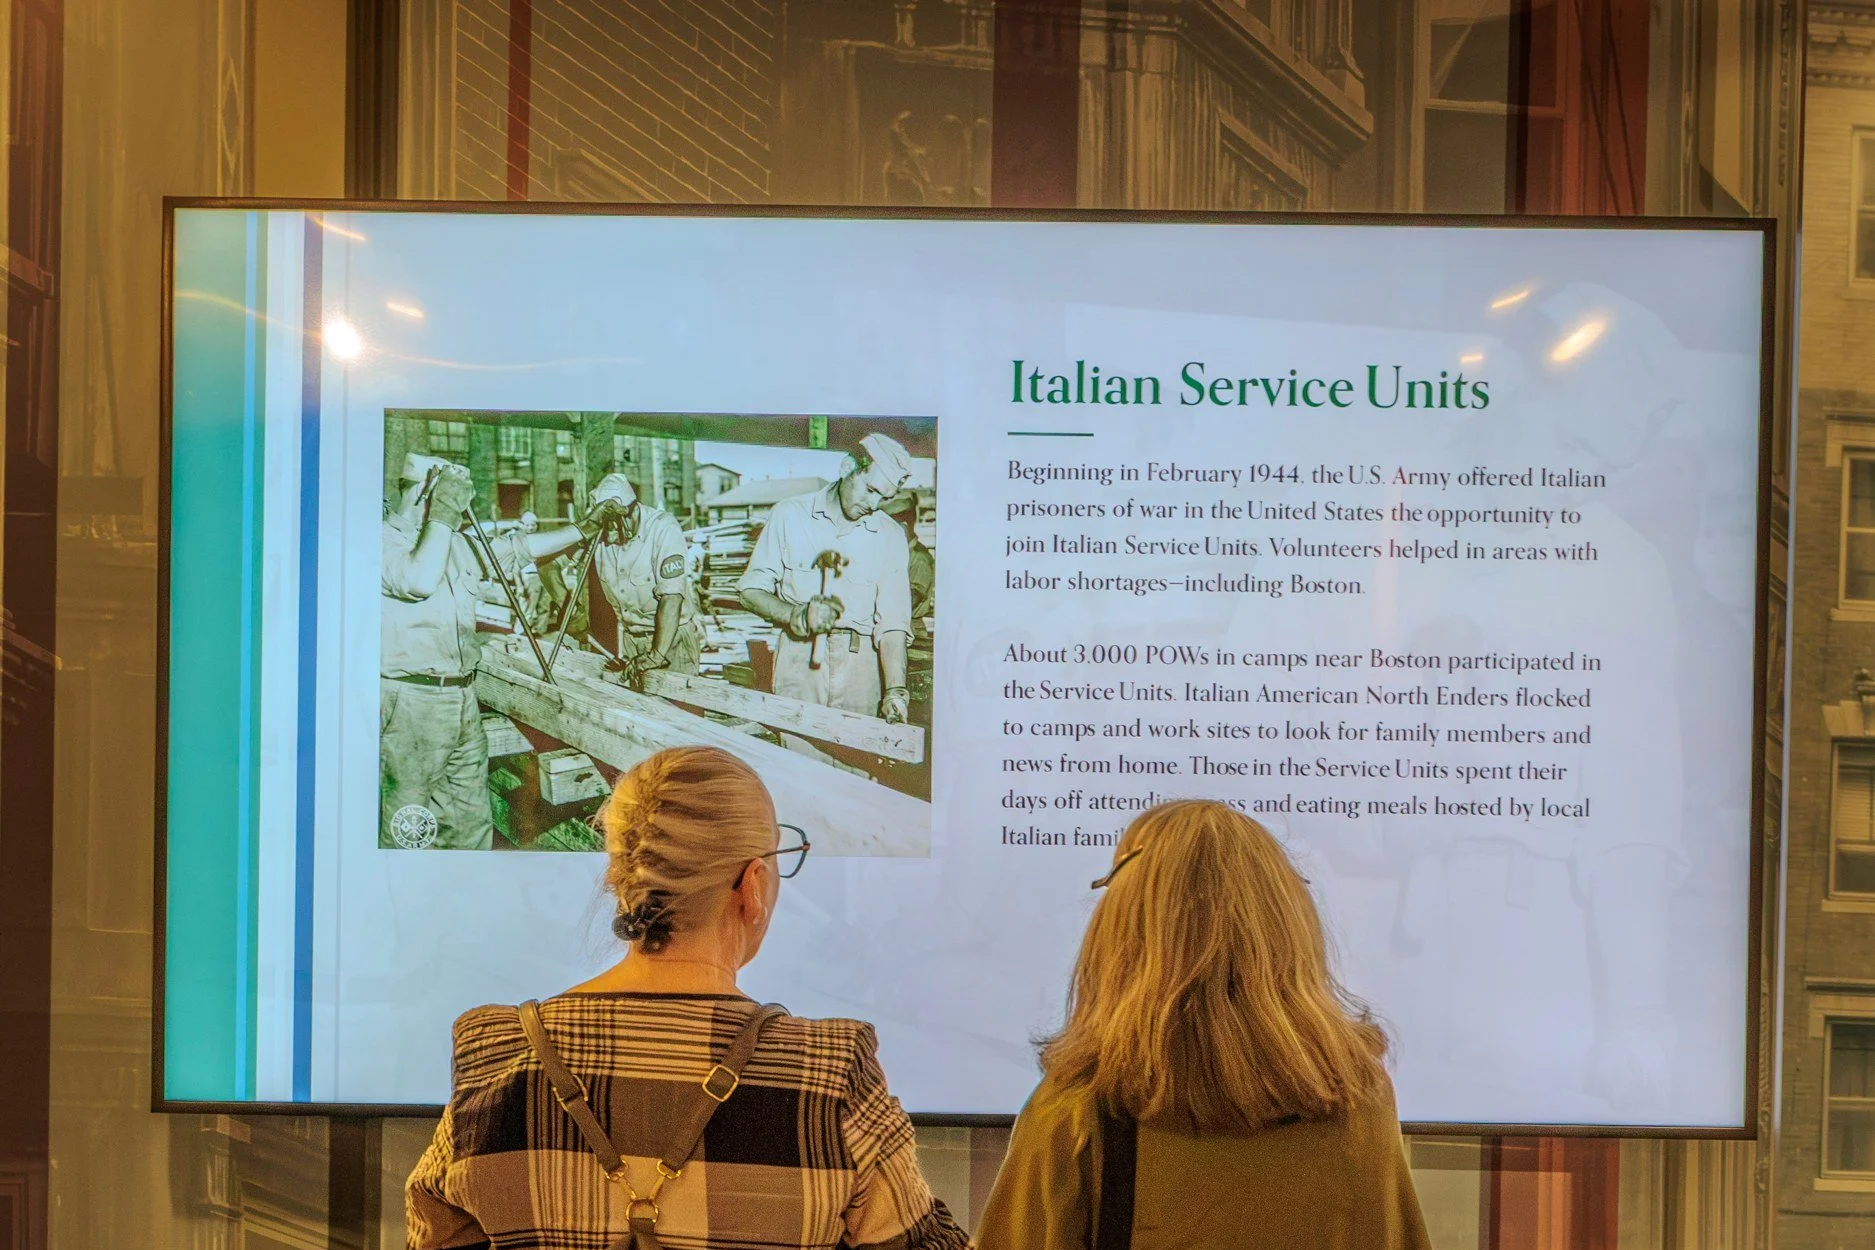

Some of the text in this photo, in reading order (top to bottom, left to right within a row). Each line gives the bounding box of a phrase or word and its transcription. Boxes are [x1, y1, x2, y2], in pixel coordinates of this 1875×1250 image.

[1010, 360, 1490, 410] Italian Service Units
[1008, 460, 1114, 486] Beginning
[1120, 464, 1139, 481] in
[1148, 462, 1242, 488] February
[1312, 464, 1344, 484] the
[1349, 465, 1385, 485] U.S.
[1392, 466, 1451, 491] Army
[1456, 466, 1533, 487] offered
[1541, 468, 1606, 487] Italian
[1007, 498, 1582, 529] prisoners of war in the United States the opportunity to
[1006, 534, 1598, 564] join Italian Service Units. Volunteers helped in areas with
[1005, 570, 1061, 589] labor
[1291, 574, 1365, 594] Boston.
[1003, 643, 1068, 663] About
[1146, 645, 1209, 665] POWs
[1217, 648, 1236, 665] in
[1242, 653, 1308, 672] camps
[1315, 654, 1363, 667] near
[1371, 648, 1441, 668] Boston
[1448, 651, 1575, 675] participated
[1582, 654, 1601, 671] in
[1004, 680, 1591, 707] the Service Units. Italian American North Enders flocked
[1003, 718, 1591, 747] to camps and work sites to look for family members and
[1002, 753, 1568, 784] news from home. Those in the Service Units spent their
[1001, 789, 1047, 814] days
[1054, 789, 1083, 809] off
[1089, 791, 1183, 810] attendi
[1254, 795, 1292, 814] and
[1296, 796, 1361, 819] eating
[1368, 795, 1427, 814] meals
[1434, 796, 1502, 816] hosted
[1510, 797, 1534, 822] by
[1541, 797, 1590, 817] local
[1002, 826, 1066, 845] Italian
